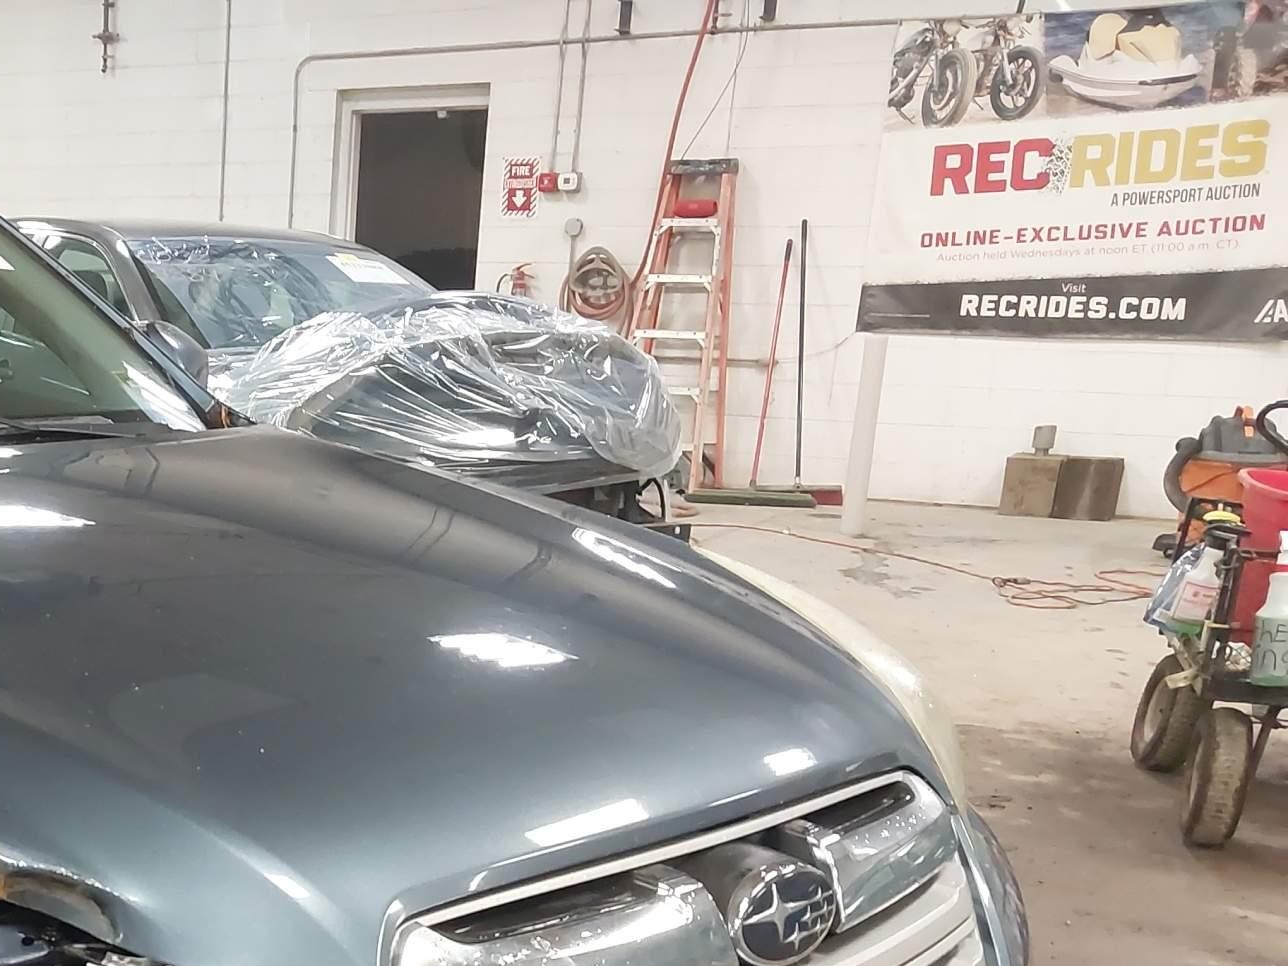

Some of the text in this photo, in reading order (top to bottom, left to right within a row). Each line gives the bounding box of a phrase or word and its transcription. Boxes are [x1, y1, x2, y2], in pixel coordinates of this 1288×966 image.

[930, 119, 1270, 196] REC RIDES
[512, 165, 531, 177] FIRE
[1111, 183, 1261, 207] A POWERSPORT AUCTION
[920, 214, 1266, 248] ONLINE-EXCLUSIVE AUCTION
[936, 252, 980, 262] Auction
[983, 250, 1007, 260] held
[1010, 247, 1081, 259] Wednesdays
[1084, 246, 1094, 255] at
[1099, 245, 1128, 255] noon
[1132, 244, 1147, 254] ET
[1061, 282, 1087, 294] Visit
[959, 294, 1187, 321] RECRIDES.COM
